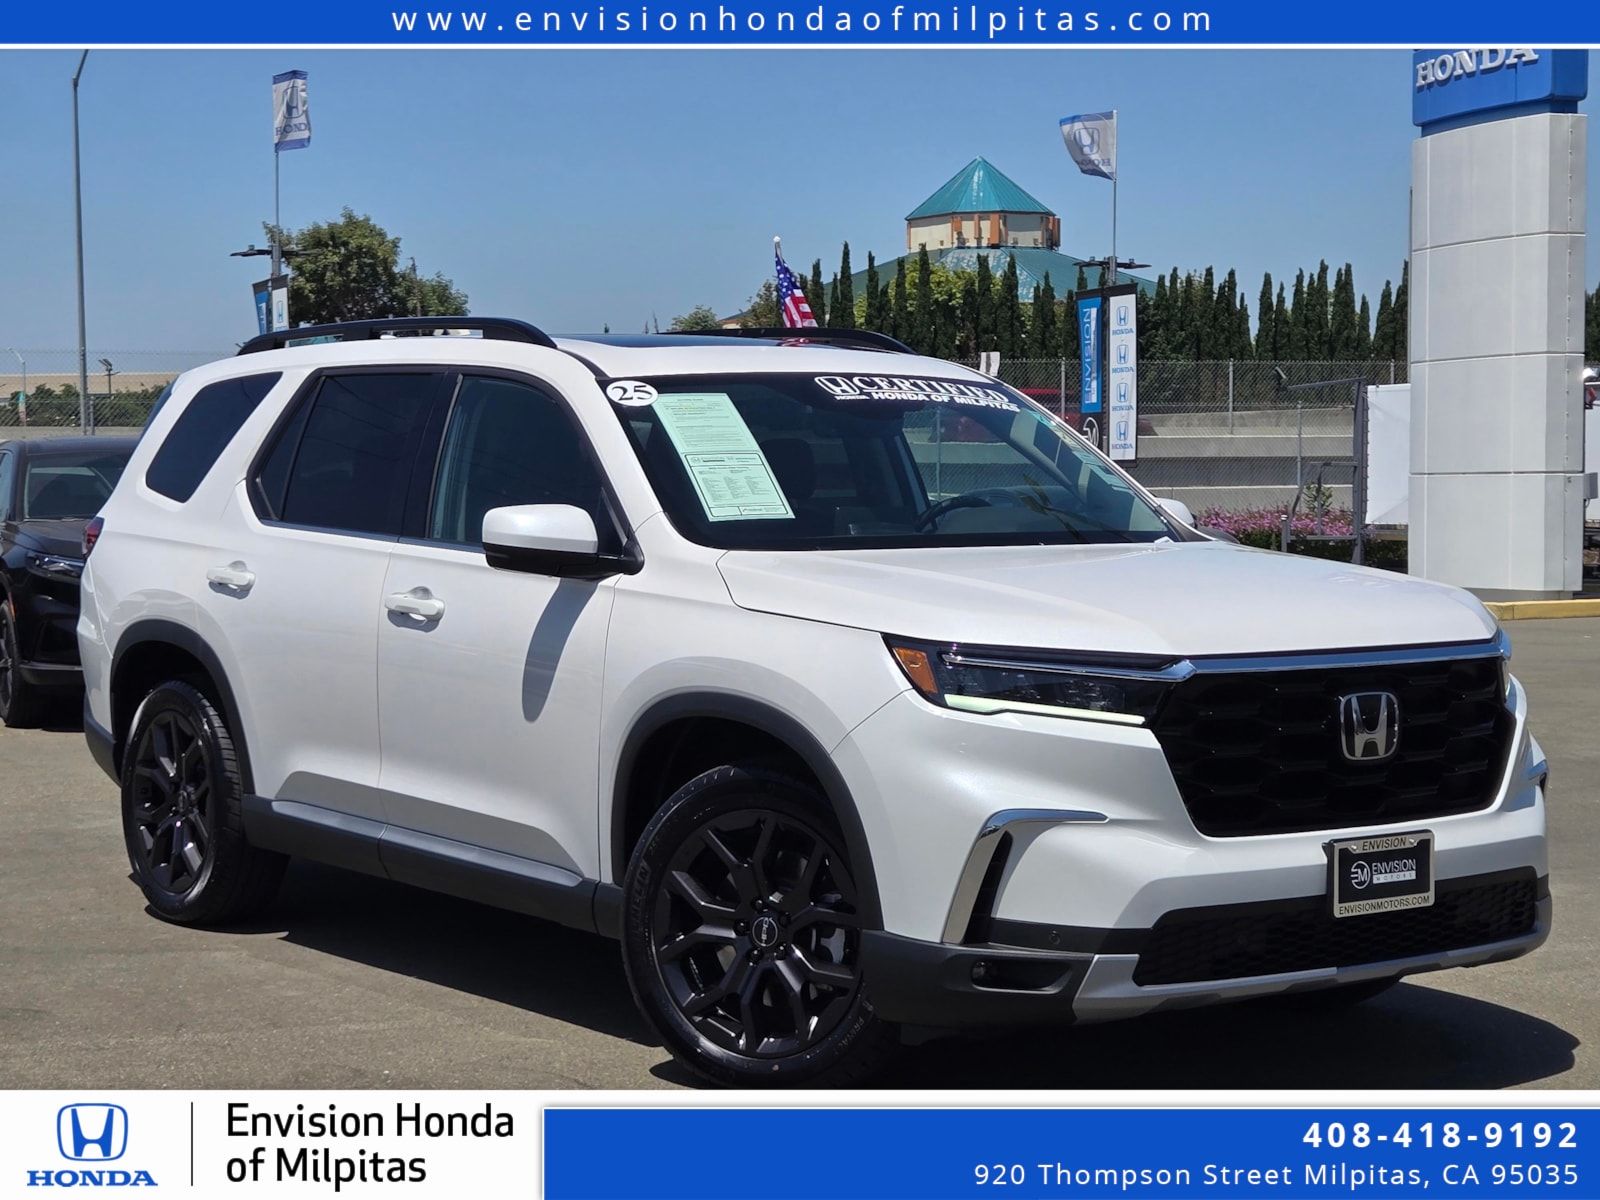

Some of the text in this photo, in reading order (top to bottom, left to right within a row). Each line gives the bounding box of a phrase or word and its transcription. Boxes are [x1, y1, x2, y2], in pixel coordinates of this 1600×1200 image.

[1416, 49, 1539, 87] HONDA
[275, 122, 309, 136] HOND
[1083, 308, 1092, 404] ENVISION
[611, 385, 652, 401] 25
[853, 376, 1009, 403] CERTIFIED
[873, 392, 1021, 412] HONDA OF MILPITAS
[1362, 837, 1407, 851] ENVISION
[1372, 859, 1416, 874] ENVISION
[1339, 895, 1430, 915] ENVISIONMOTORS.COM
